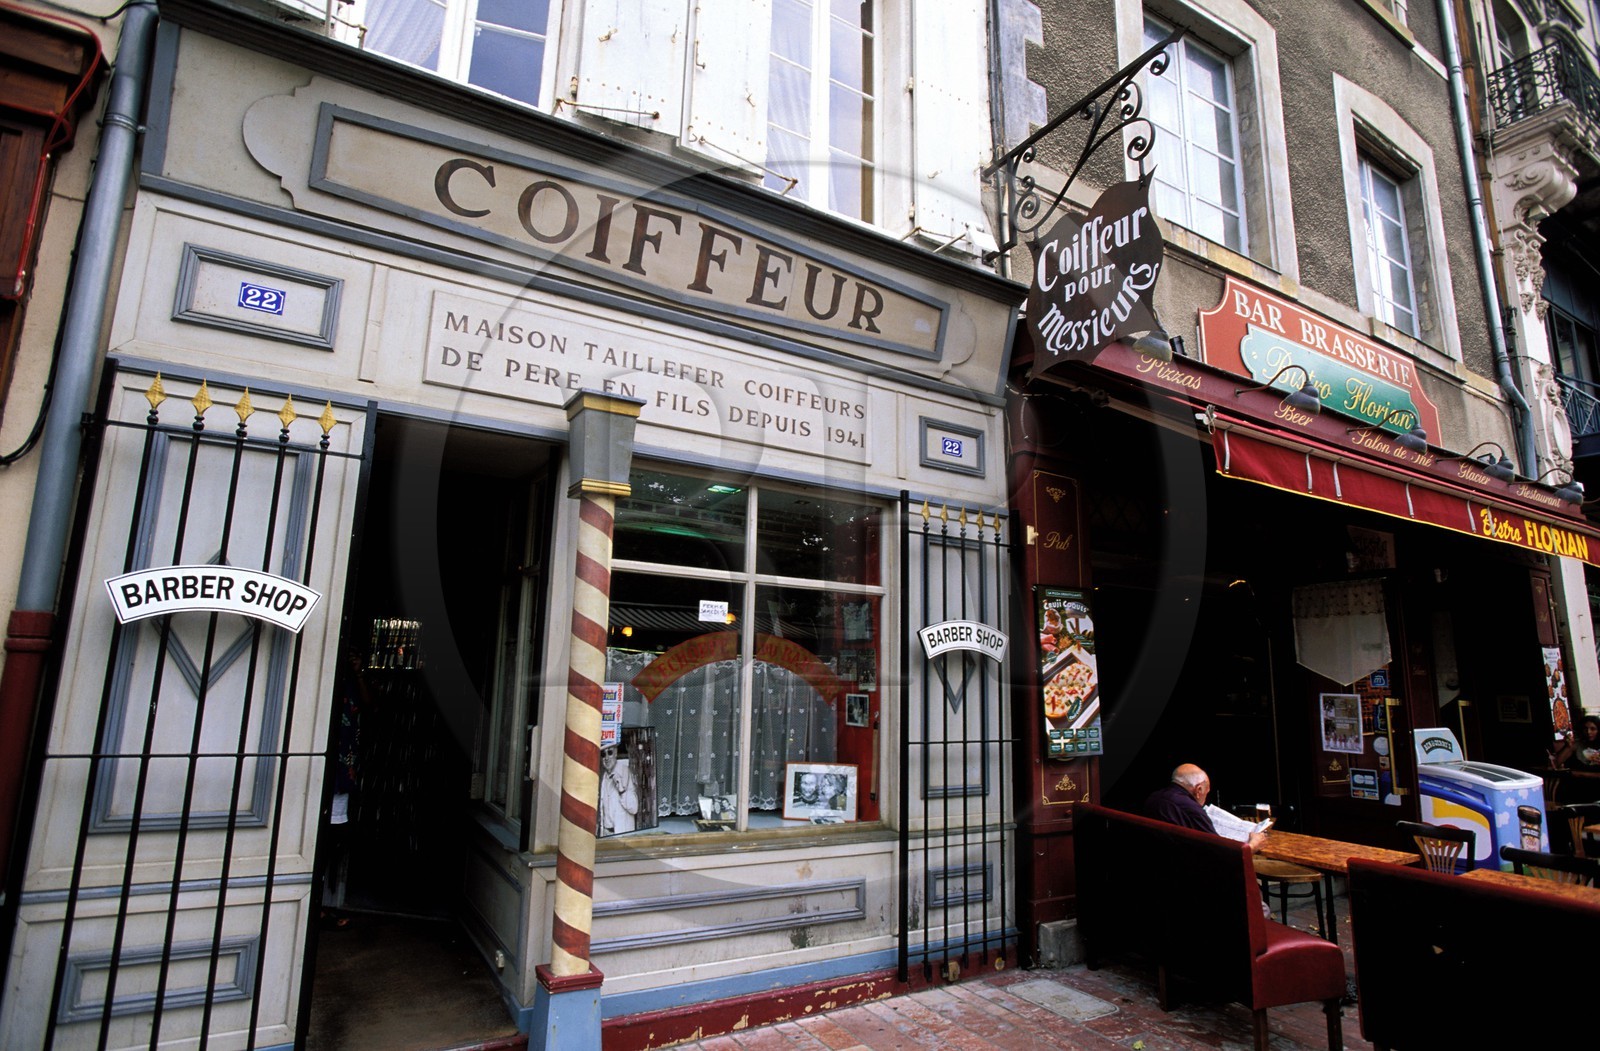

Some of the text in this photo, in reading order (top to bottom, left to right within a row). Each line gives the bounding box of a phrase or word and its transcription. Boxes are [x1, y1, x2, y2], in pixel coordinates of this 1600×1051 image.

[433, 157, 884, 335] COIFFEUR
[1037, 206, 1147, 293] Coiffeur
[244, 288, 278, 310] 22
[1064, 262, 1116, 302] pour
[1232, 288, 1413, 388] BAR BRASSERIE
[443, 310, 866, 421] MAISON TAILLEFER COIFFEURS
[1136, 354, 1202, 390] Pizzas
[440, 346, 483, 372] DE
[504, 358, 582, 391] PERE
[656, 389, 710, 417] FILS
[728, 404, 812, 438] DEPUIS
[826, 425, 866, 449] 1941
[1261, 345, 1413, 431] Bistro Florian
[1273, 399, 1314, 427] Beer
[944, 439, 960, 455] 22
[1351, 428, 1391, 458] Salon
[1393, 444, 1408, 460] de
[1457, 461, 1492, 485] Glacier
[1515, 484, 1563, 509] Restaurant
[1043, 531, 1074, 551] Pub
[1480, 508, 1589, 560] Bistro FLORIAN
[120, 574, 308, 617] BARBER SHOP
[926, 625, 1004, 651] BARBER SHOP
